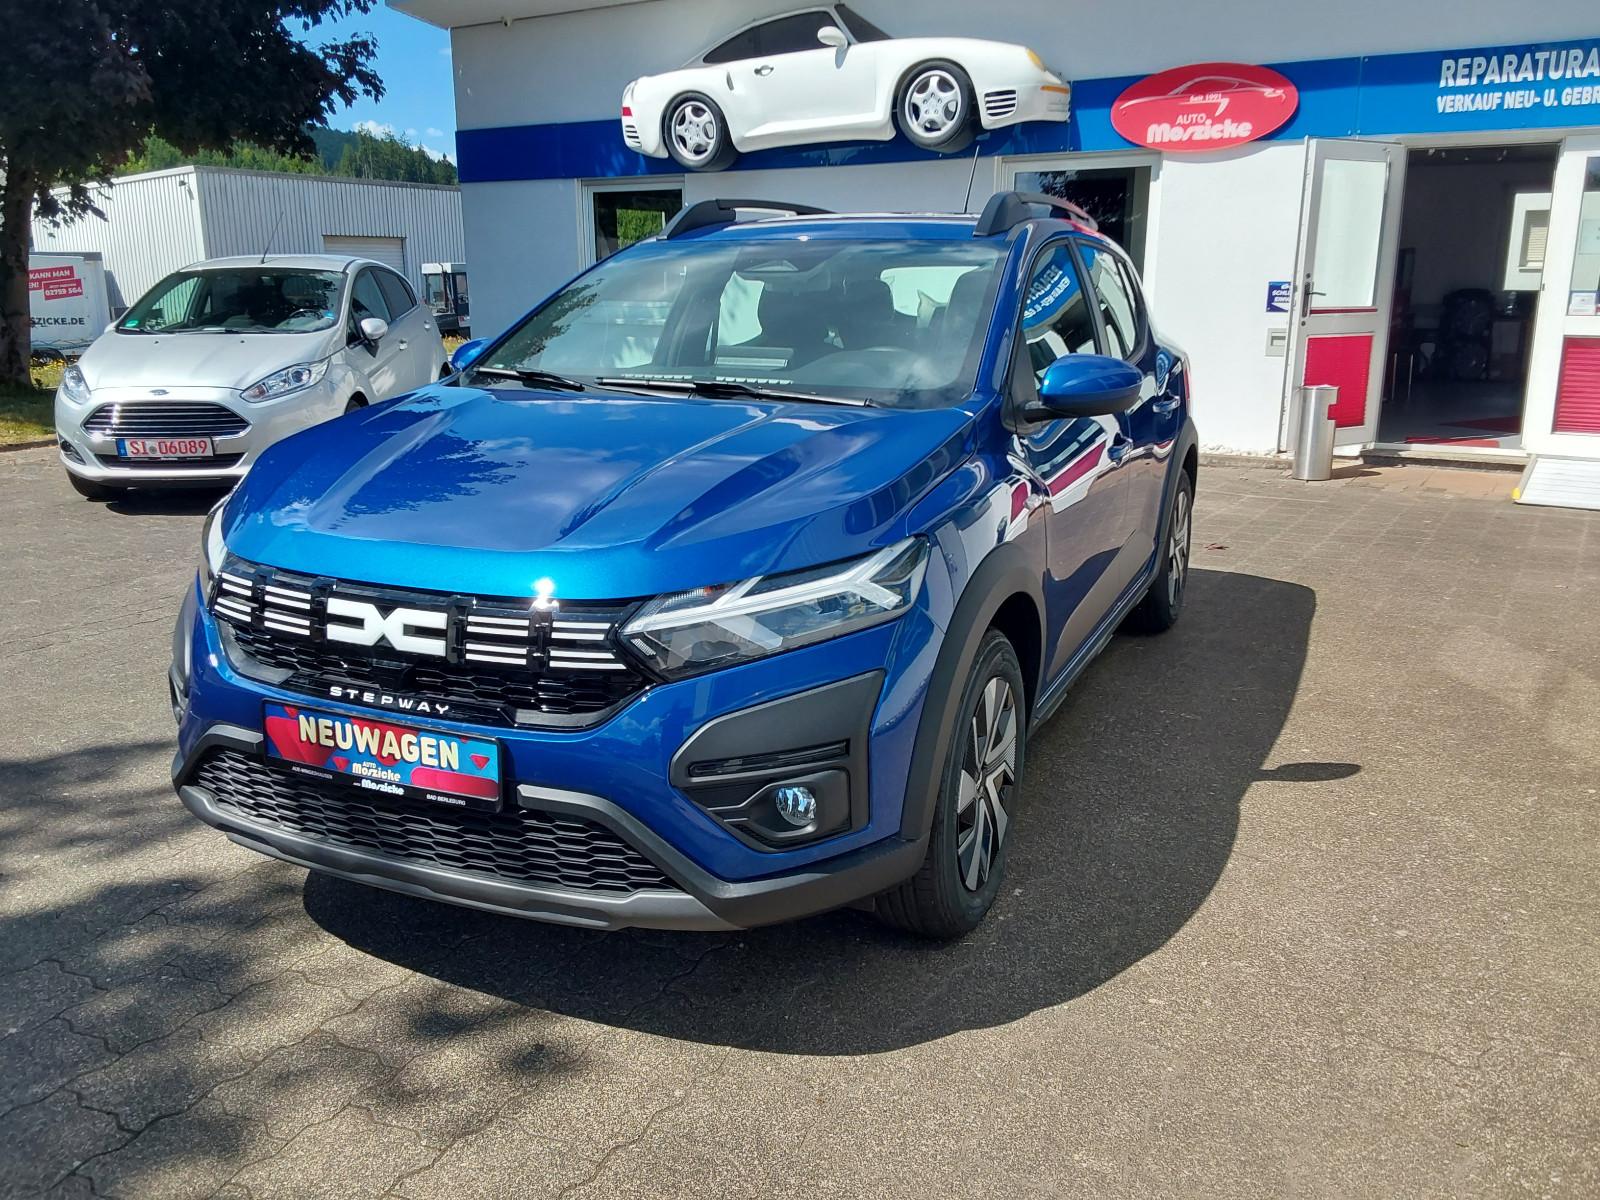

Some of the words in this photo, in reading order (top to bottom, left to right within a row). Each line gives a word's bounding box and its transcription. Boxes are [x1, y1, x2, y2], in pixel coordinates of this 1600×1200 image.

[1438, 47, 1600, 88] REPARATURA
[1436, 92, 1502, 113] VERKAUF
[1503, 90, 1541, 110] NEU-
[1543, 88, 1558, 107] U.
[1175, 113, 1207, 125] AUTO
[29, 271, 51, 280] KANN
[53, 269, 71, 277] MAN
[129, 440, 149, 455] SI
[157, 439, 208, 455] 06089
[329, 686, 449, 714] STEPWAY
[298, 714, 460, 770] NEUWAGEN
[362, 761, 377, 769] AUTO
